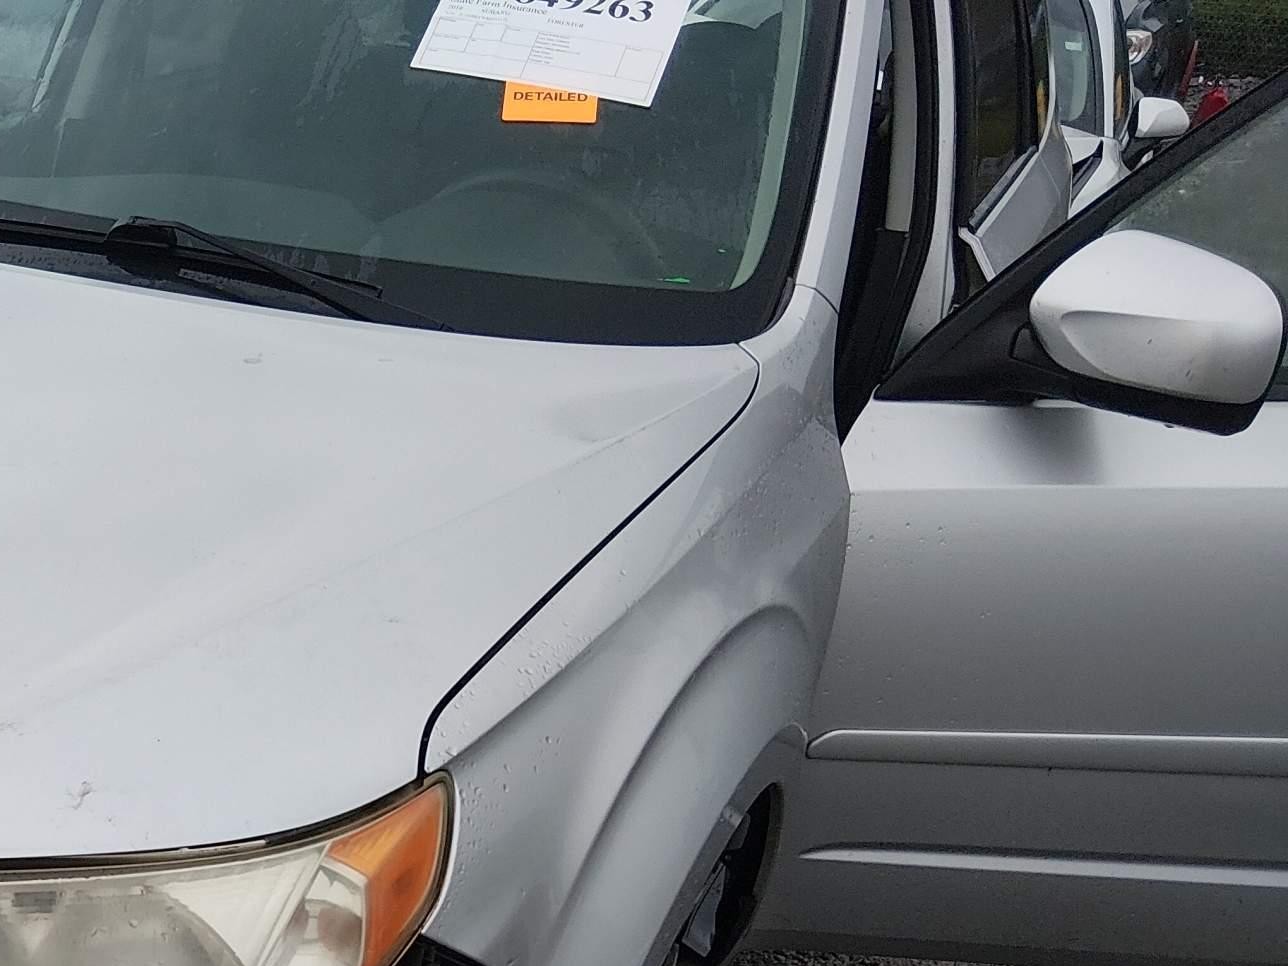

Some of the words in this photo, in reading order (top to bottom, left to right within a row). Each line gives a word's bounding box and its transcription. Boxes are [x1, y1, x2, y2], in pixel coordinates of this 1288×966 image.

[502, 2, 548, 15] Insurance
[515, 0, 654, 22] 263
[513, 91, 588, 104] DETAILED
